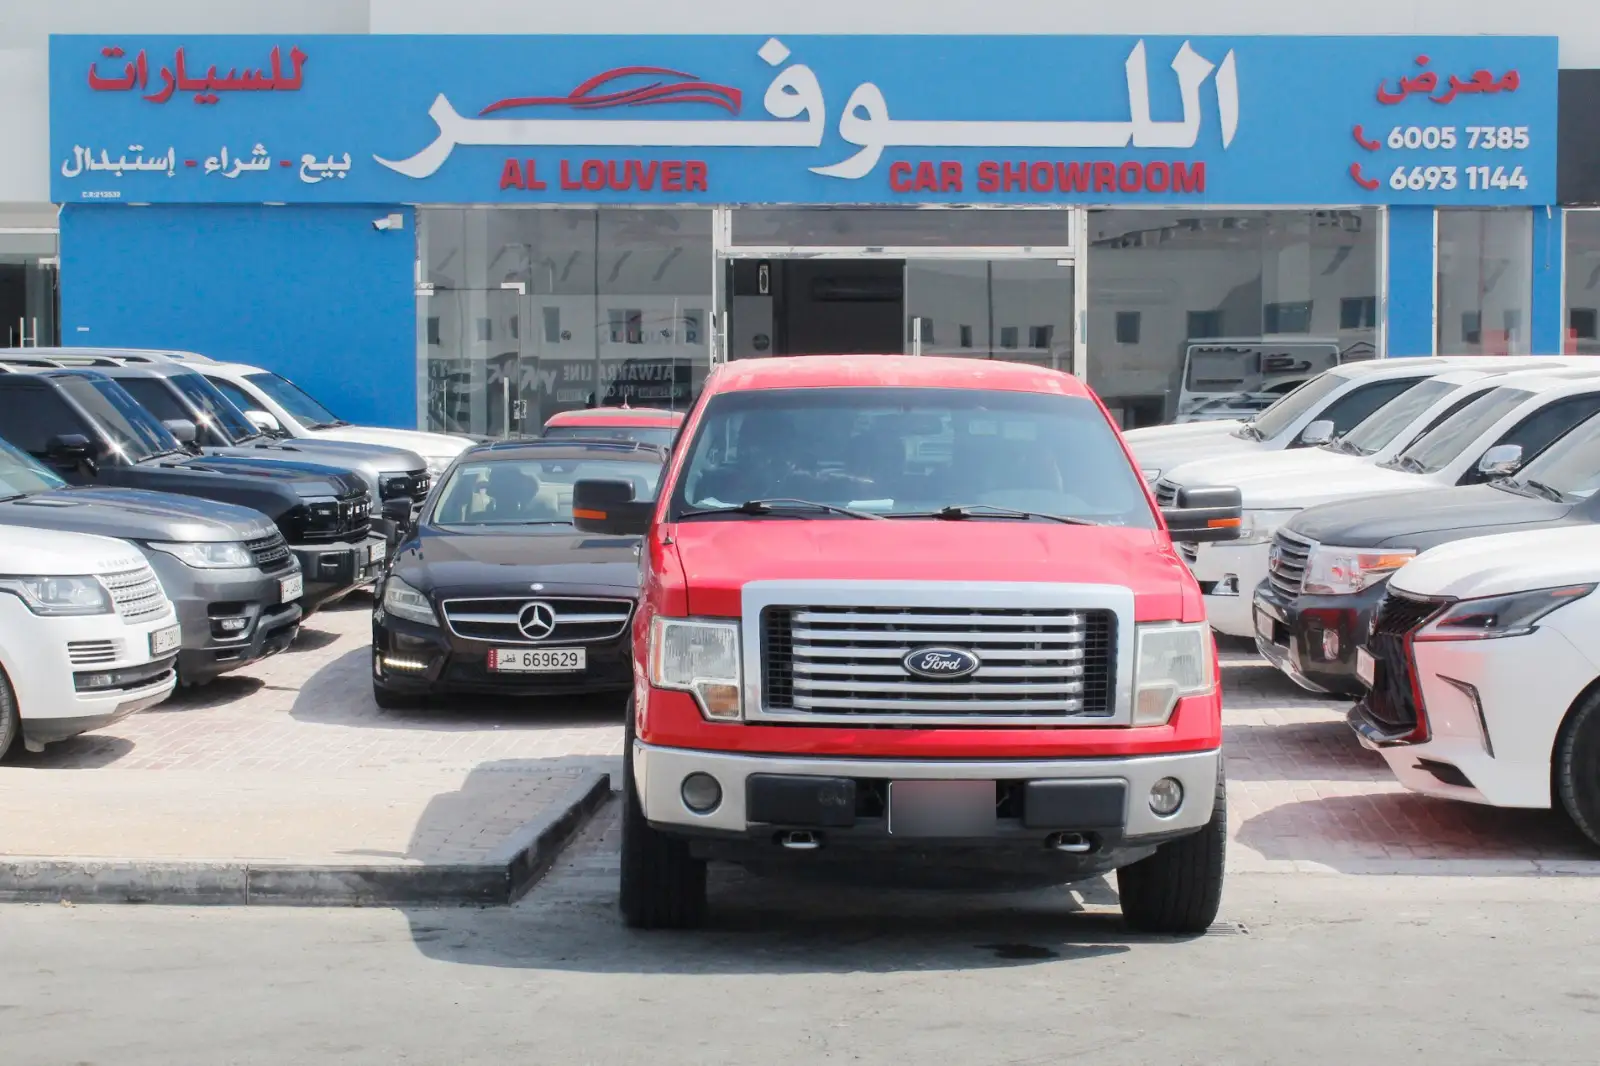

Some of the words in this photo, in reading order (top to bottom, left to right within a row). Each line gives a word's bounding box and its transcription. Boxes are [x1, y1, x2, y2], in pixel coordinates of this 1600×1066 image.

[88, 44, 308, 104] للسيارات
[1376, 54, 1521, 104] معرض
[1387, 126, 1457, 150] 6005
[1465, 126, 1530, 150] 7385
[61, 144, 175, 177] إستبدال
[204, 143, 271, 178] شراء
[300, 151, 351, 183] بيع
[500, 159, 546, 191] AL
[560, 160, 708, 192] LOUVER
[889, 161, 963, 193] CAR
[977, 161, 1206, 193] SHOWROOM
[1389, 166, 1457, 190] 6693
[1465, 166, 1528, 190] 1144
[523, 652, 578, 667] 669629
[921, 652, 962, 670] Ford
